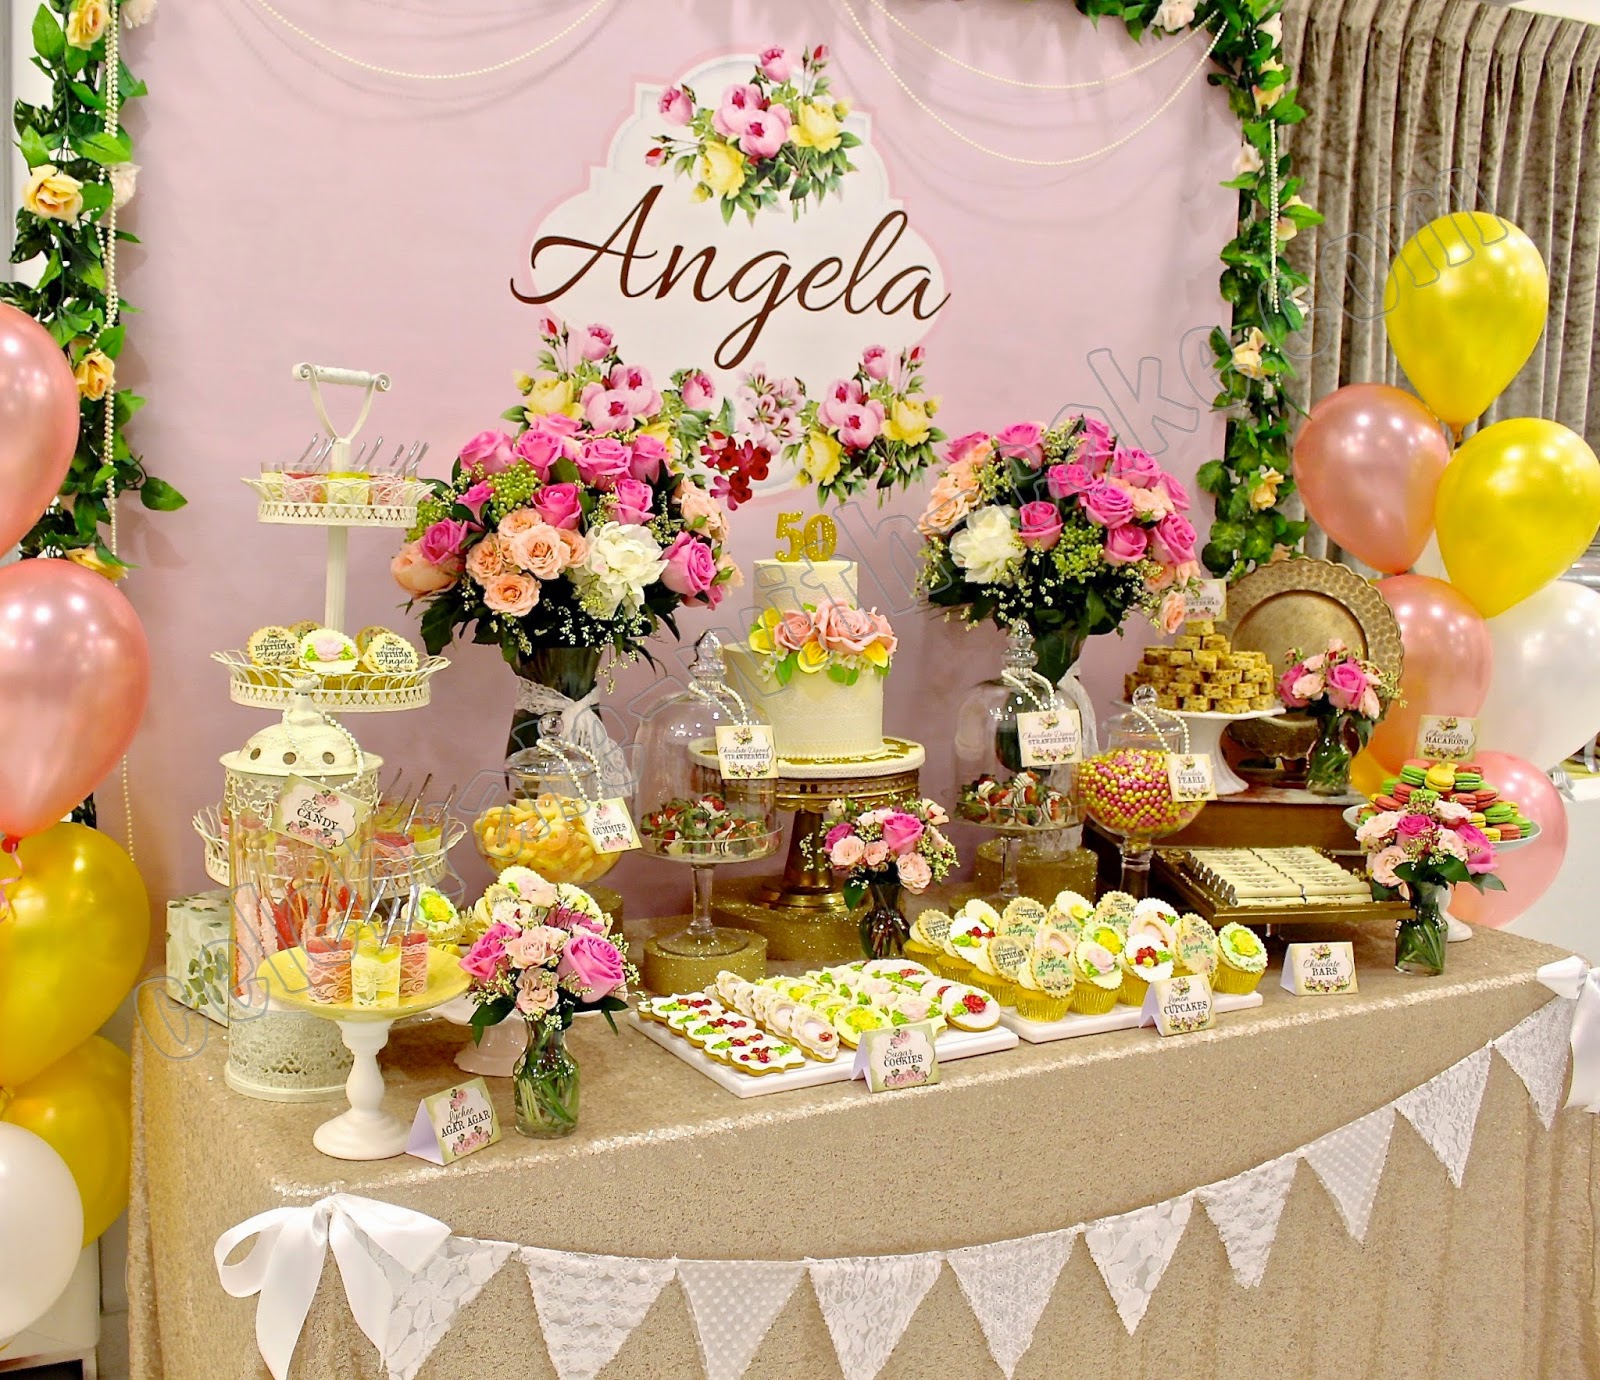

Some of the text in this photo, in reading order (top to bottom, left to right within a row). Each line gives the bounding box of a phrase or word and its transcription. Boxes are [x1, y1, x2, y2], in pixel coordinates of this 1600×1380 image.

[510, 184, 951, 369] Angela
[775, 511, 837, 562] 50
[255, 643, 296, 651] BIRTHDAY
[256, 650, 297, 661] Angela
[378, 657, 415, 667] Angela
[1023, 730, 1052, 740] Chocolate
[1028, 737, 1076, 745] STRAWBERRIES
[1424, 736, 1469, 746] MACARONS
[719, 746, 770, 754] Chocolate Dipped
[1178, 776, 1206, 784] PEARLS
[296, 808, 339, 830] CANDY
[592, 823, 628, 836] GUMMIES
[1303, 959, 1341, 968] Chocolate
[1312, 967, 1338, 976] BARS
[1163, 1001, 1208, 1015] CUPCAKES
[884, 1049, 913, 1060] Sugar
[883, 1054, 924, 1067] COOKIES
[441, 1110, 491, 1138] AGAR AGAR
